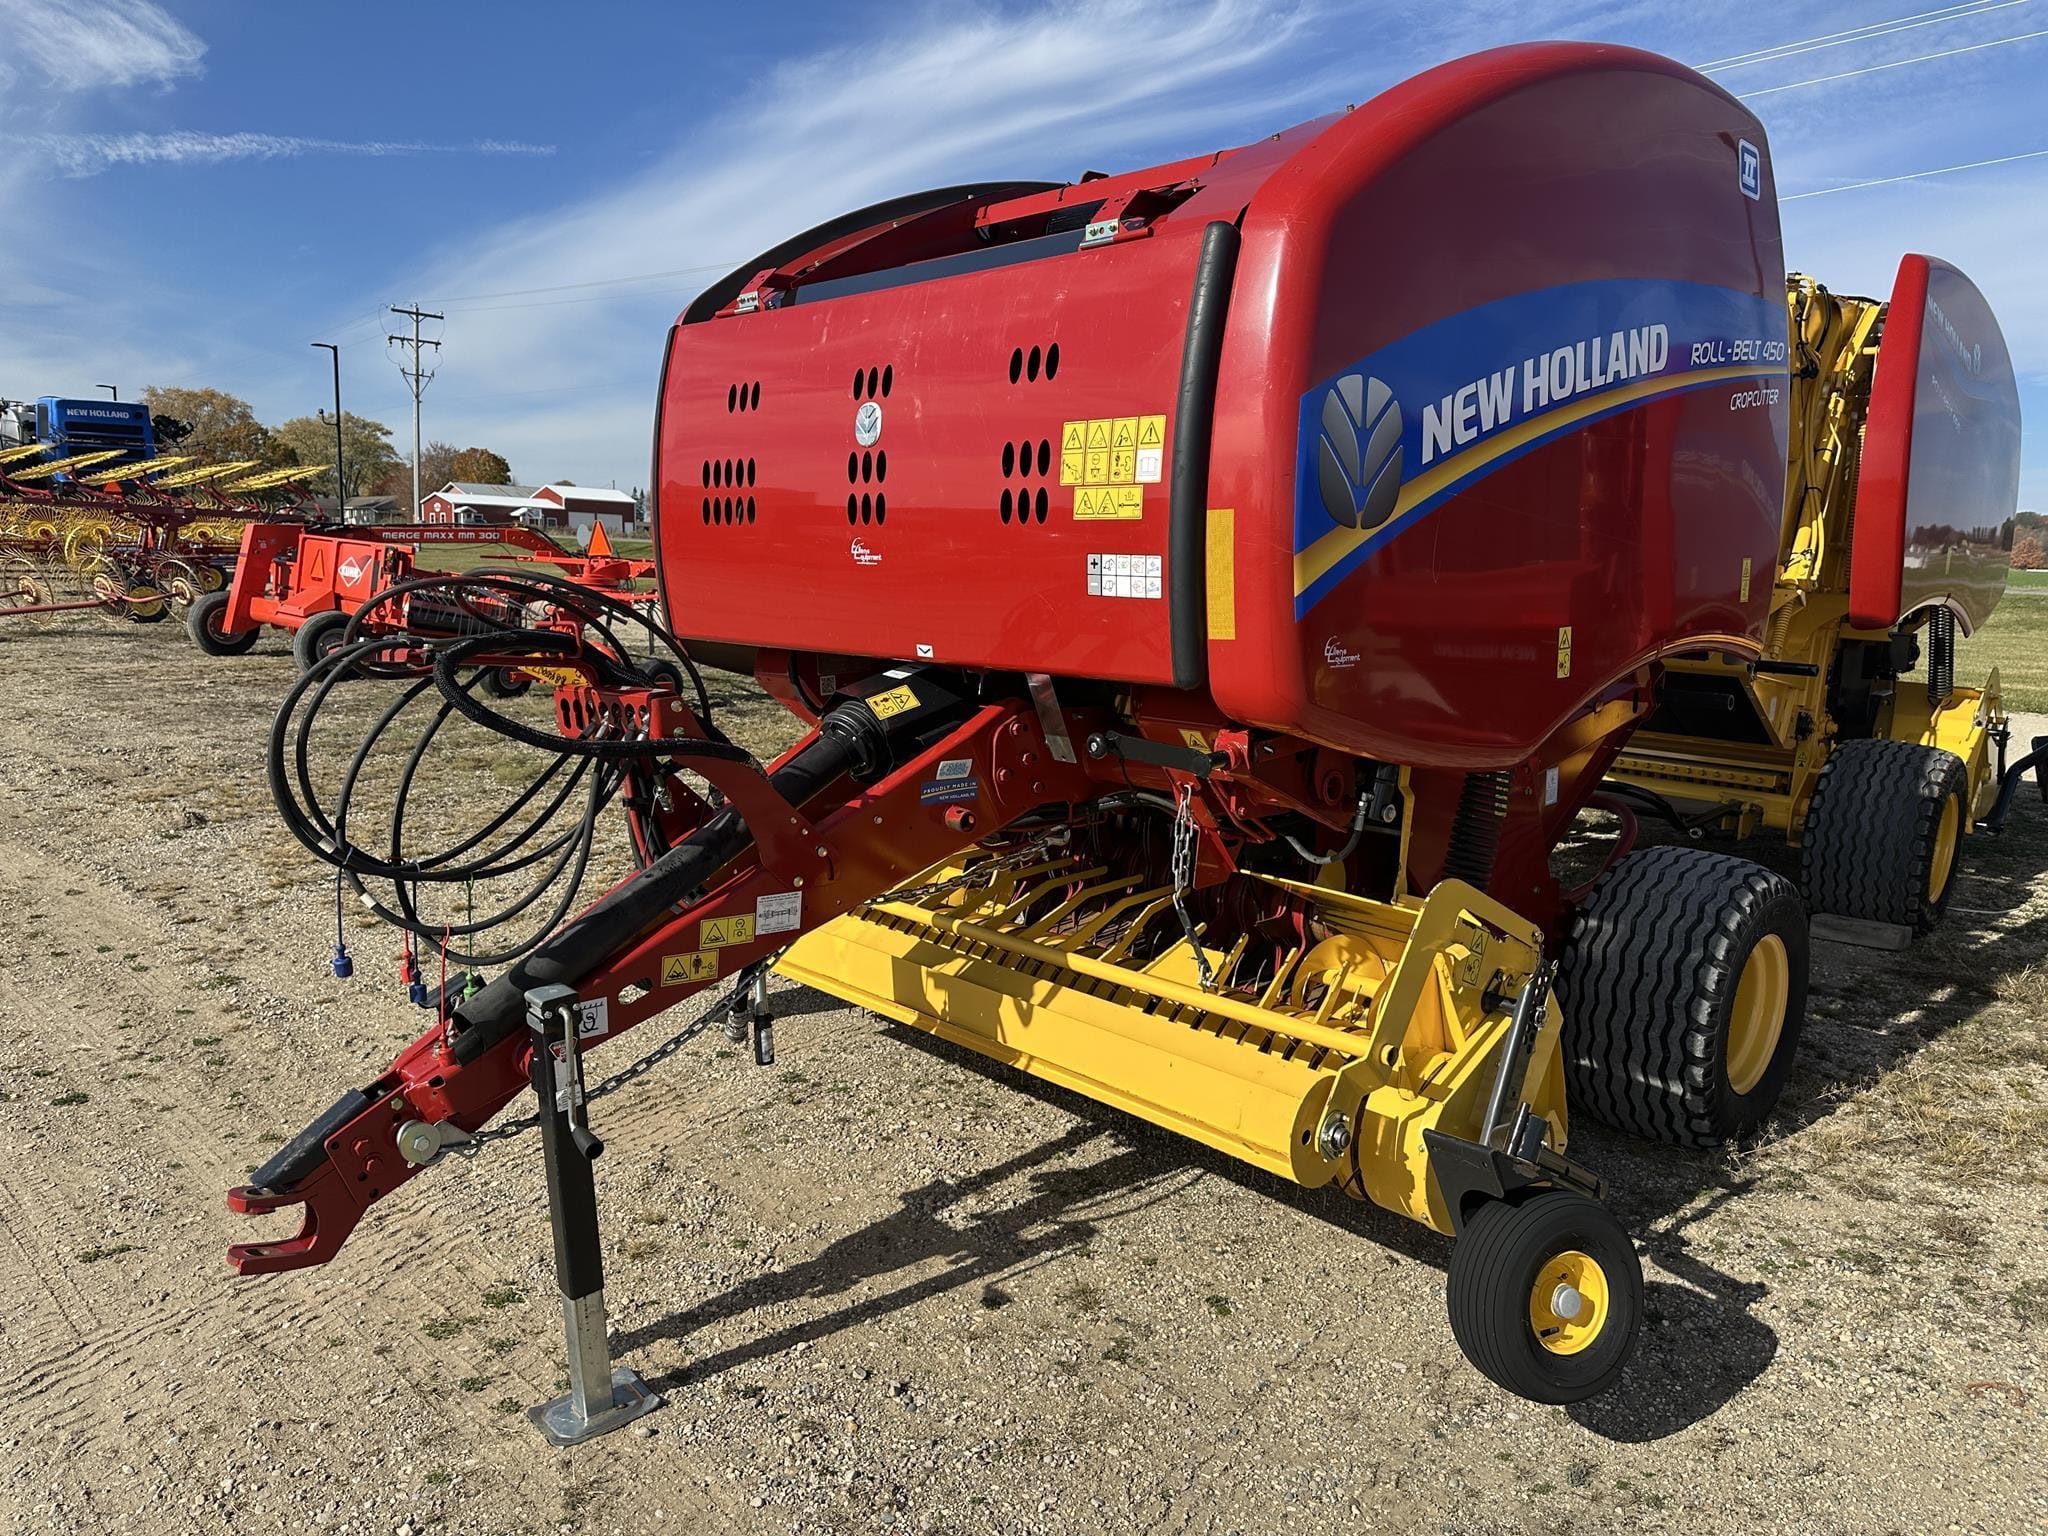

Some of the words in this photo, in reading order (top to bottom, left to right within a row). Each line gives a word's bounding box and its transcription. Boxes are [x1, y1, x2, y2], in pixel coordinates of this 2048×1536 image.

[1691, 340, 1761, 365] ROLL-BELT
[1763, 341, 1785, 361] 450
[1422, 366, 1515, 465] NEW
[1522, 323, 1669, 414] HOLLAND
[1730, 389, 1779, 411] CROPCUTTER
[66, 408, 88, 416] NEW
[89, 409, 130, 419] HOLLAND
[382, 532, 421, 540] MERGE
[423, 532, 455, 540] MAXX
[458, 532, 476, 540] MM
[478, 532, 500, 540] 300
[923, 785, 951, 794] PROUDLY
